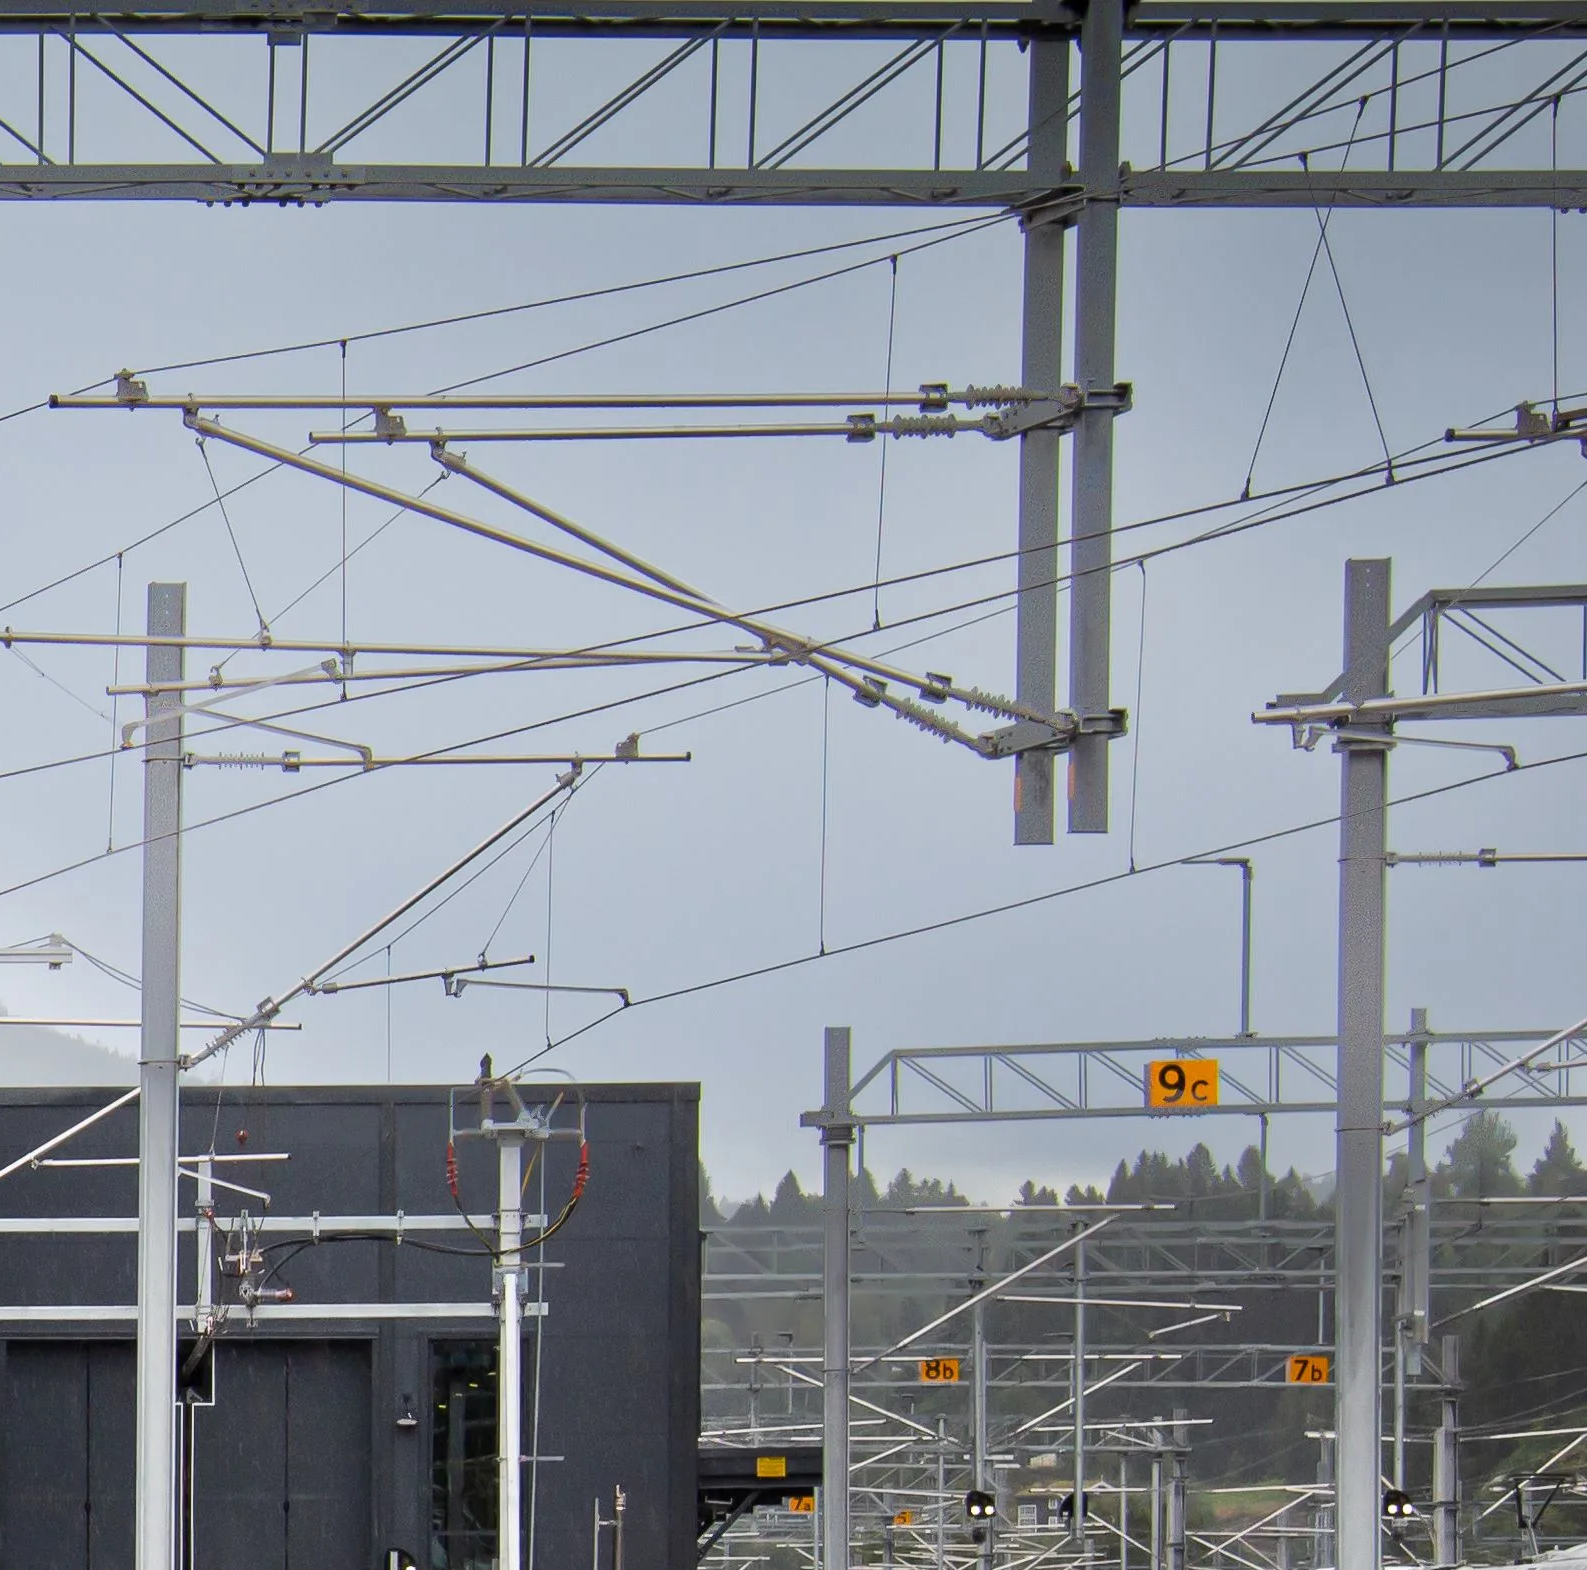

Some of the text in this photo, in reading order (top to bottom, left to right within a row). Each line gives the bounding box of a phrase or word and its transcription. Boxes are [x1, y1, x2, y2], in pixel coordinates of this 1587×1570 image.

[1158, 1063, 1209, 1103] 9c
[925, 1359, 954, 1380] 8b
[1293, 1359, 1323, 1381] 7b
